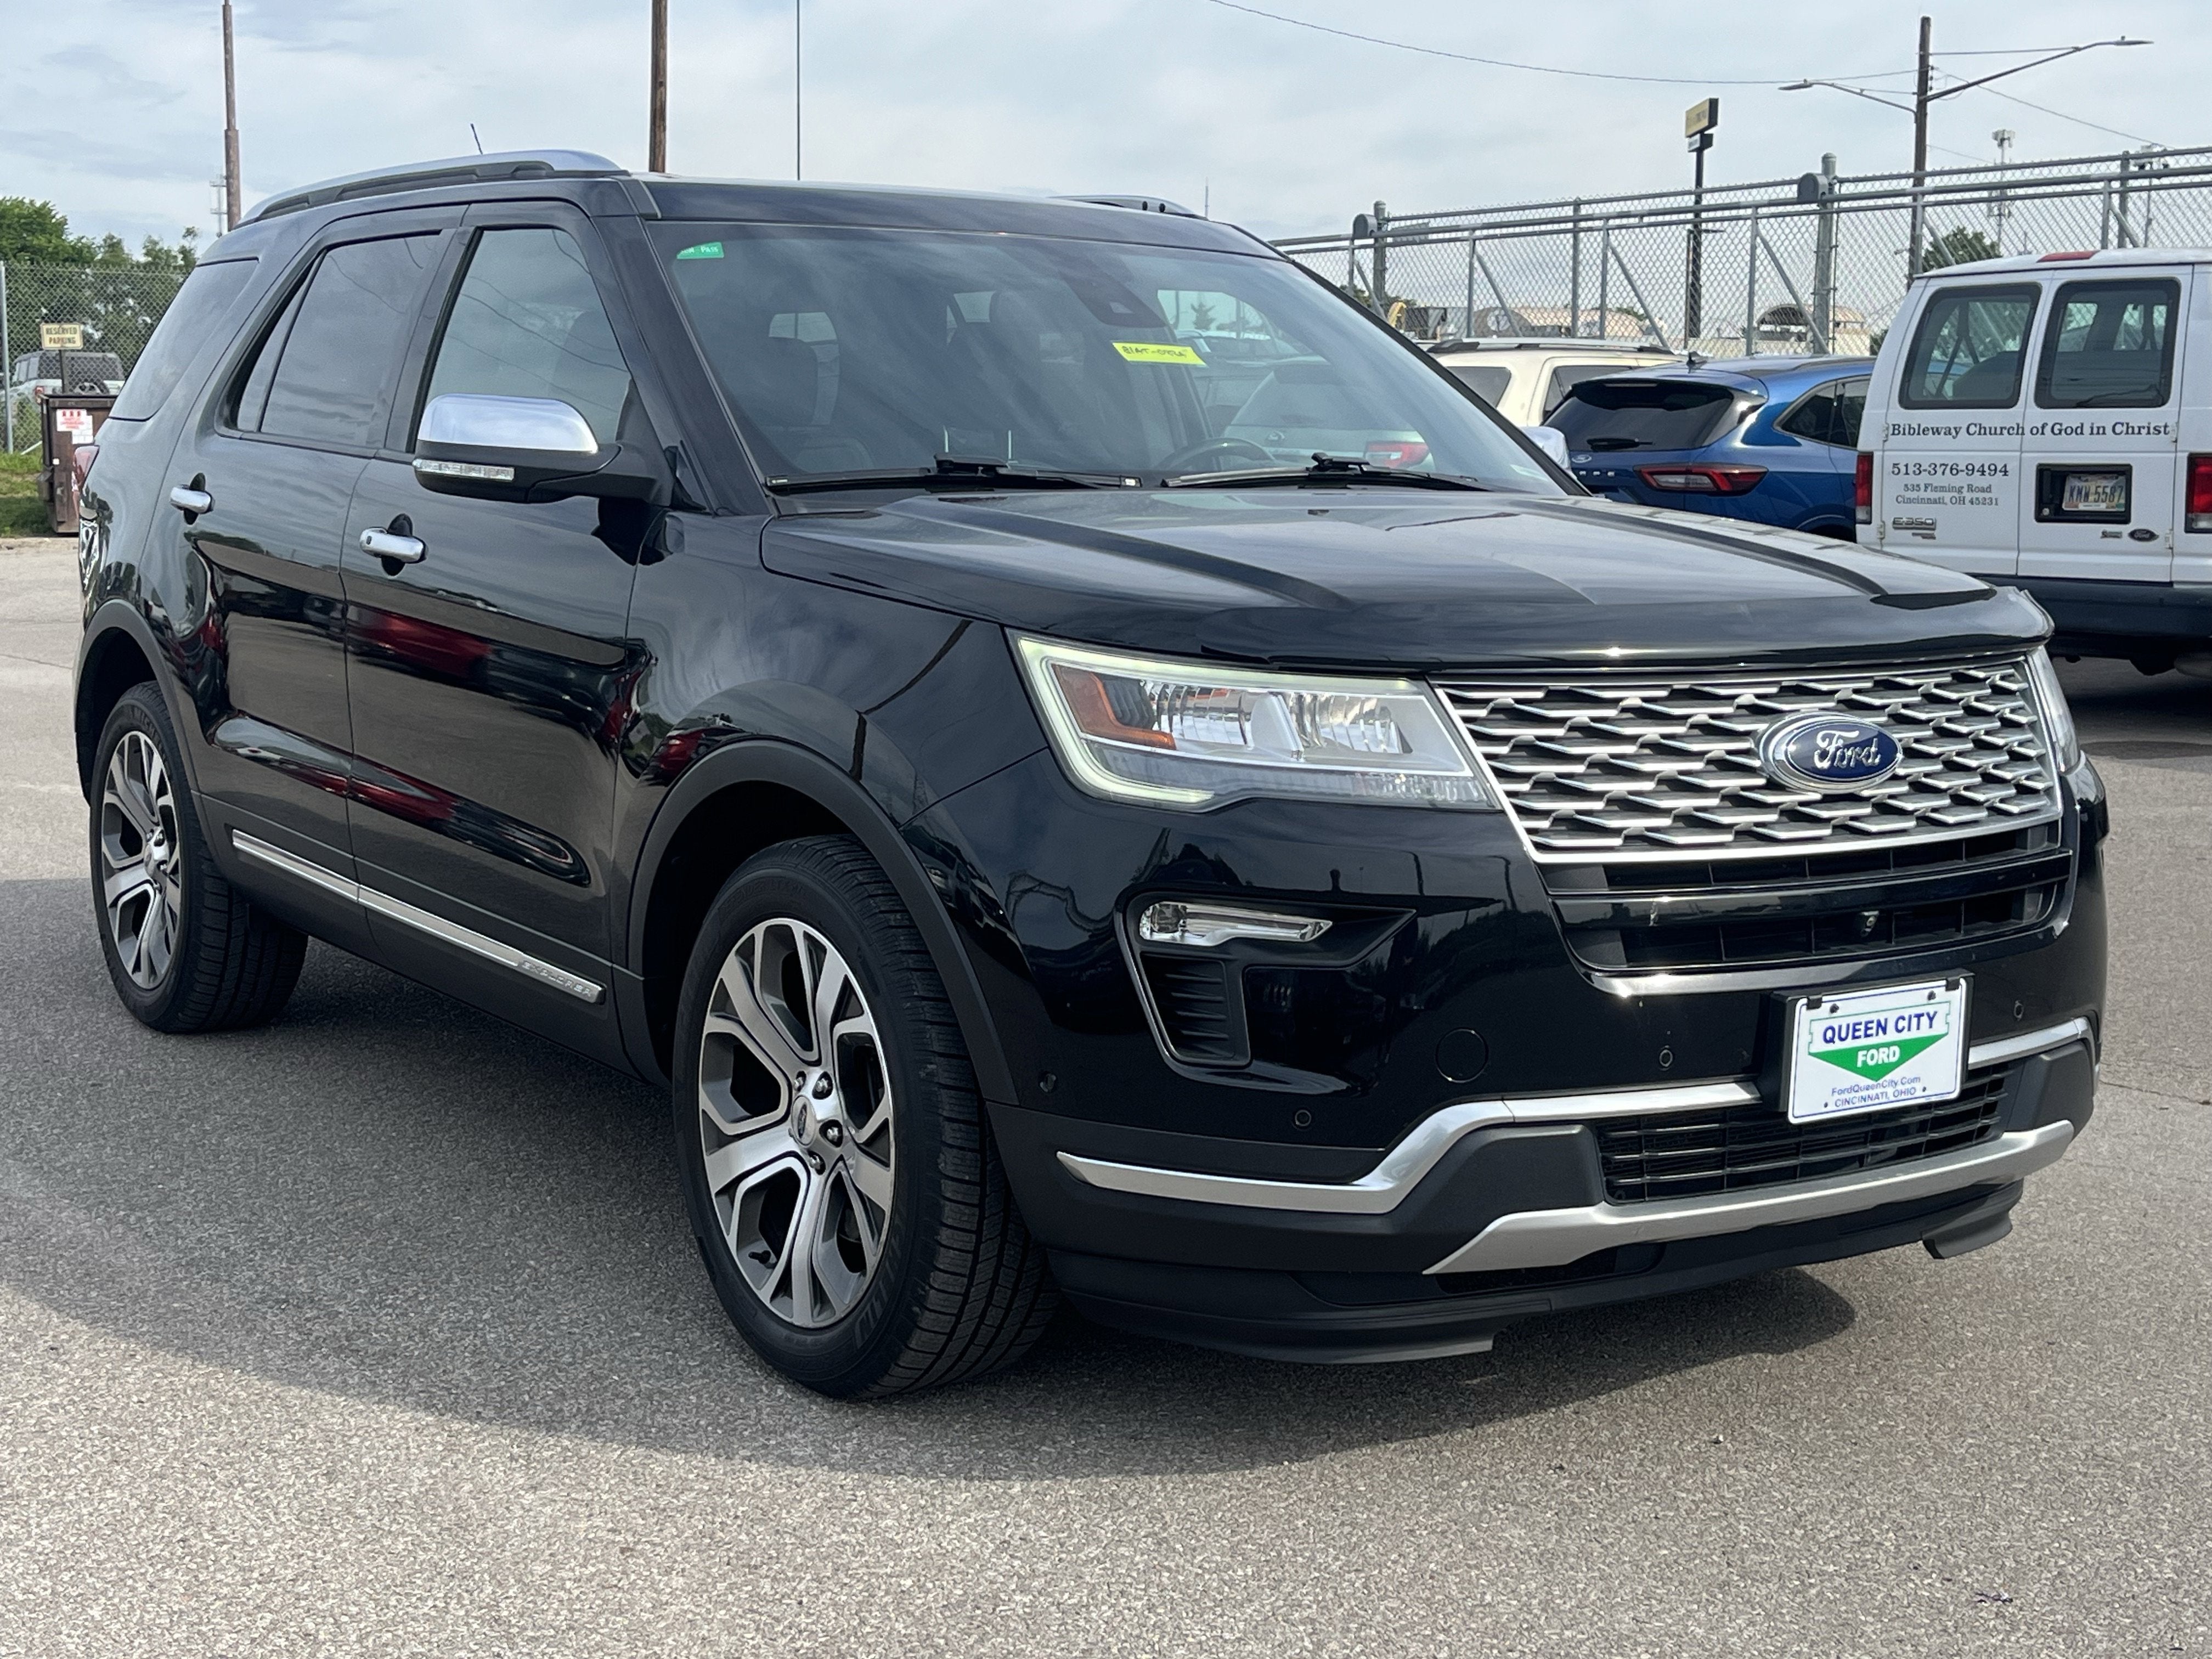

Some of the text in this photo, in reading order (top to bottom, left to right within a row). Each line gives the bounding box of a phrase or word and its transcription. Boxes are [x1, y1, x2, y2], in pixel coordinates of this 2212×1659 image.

[1891, 422, 2170, 439] Bibleway Church of God in Christ
[1892, 462, 2009, 476] 513-376-9494
[1903, 483, 1992, 494] 535 Fleming Road
[2094, 485, 2124, 503] 5587
[1950, 496, 1966, 505] OH
[1968, 496, 1999, 506] 45231
[1814, 730, 1881, 769] Ford
[1822, 1011, 1938, 1044] QUEEN CITY
[1857, 1045, 1900, 1068] FORD
[1831, 1076, 1921, 1096] FordQueenCity.Com
[1893, 1087, 1916, 1098] OHIO
